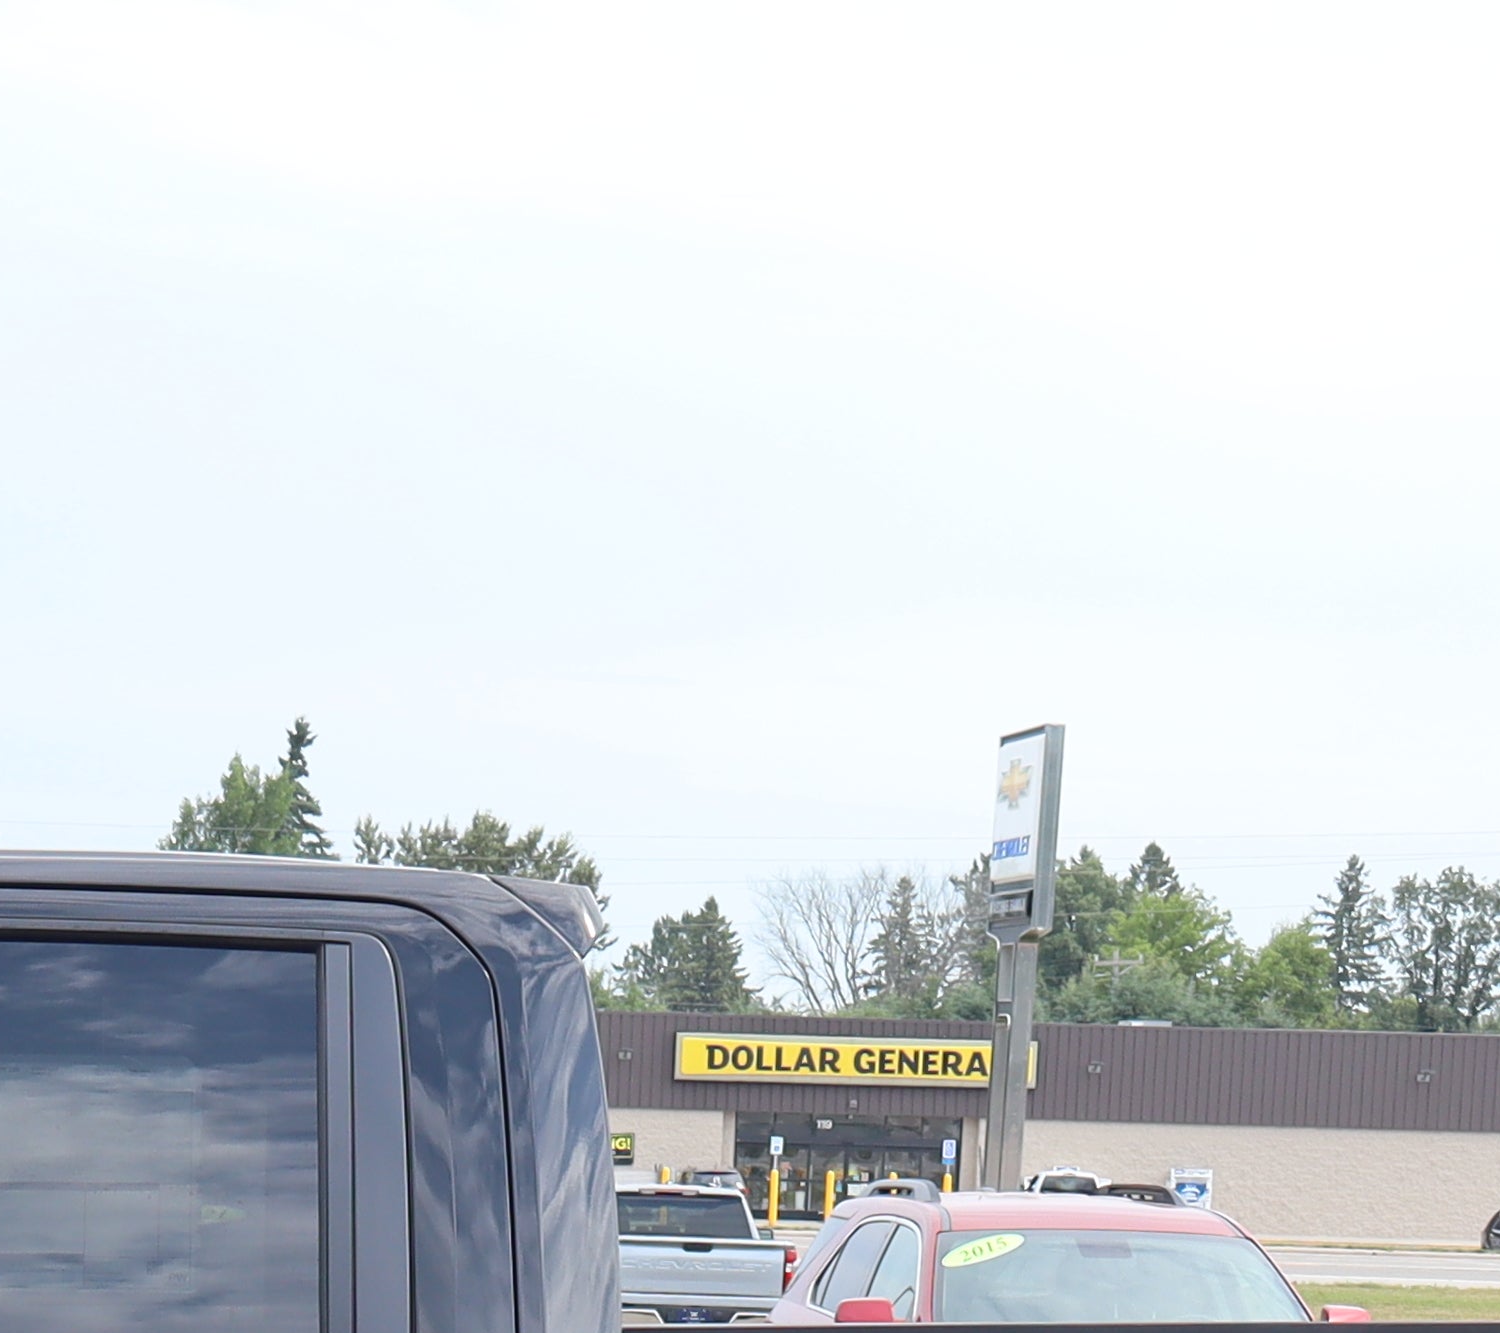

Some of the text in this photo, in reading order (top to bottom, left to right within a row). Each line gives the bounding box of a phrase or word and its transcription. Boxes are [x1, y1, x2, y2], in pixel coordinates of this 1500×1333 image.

[706, 1045, 989, 1077] DOLLAR GENERA
[959, 1236, 1008, 1263] 2015
